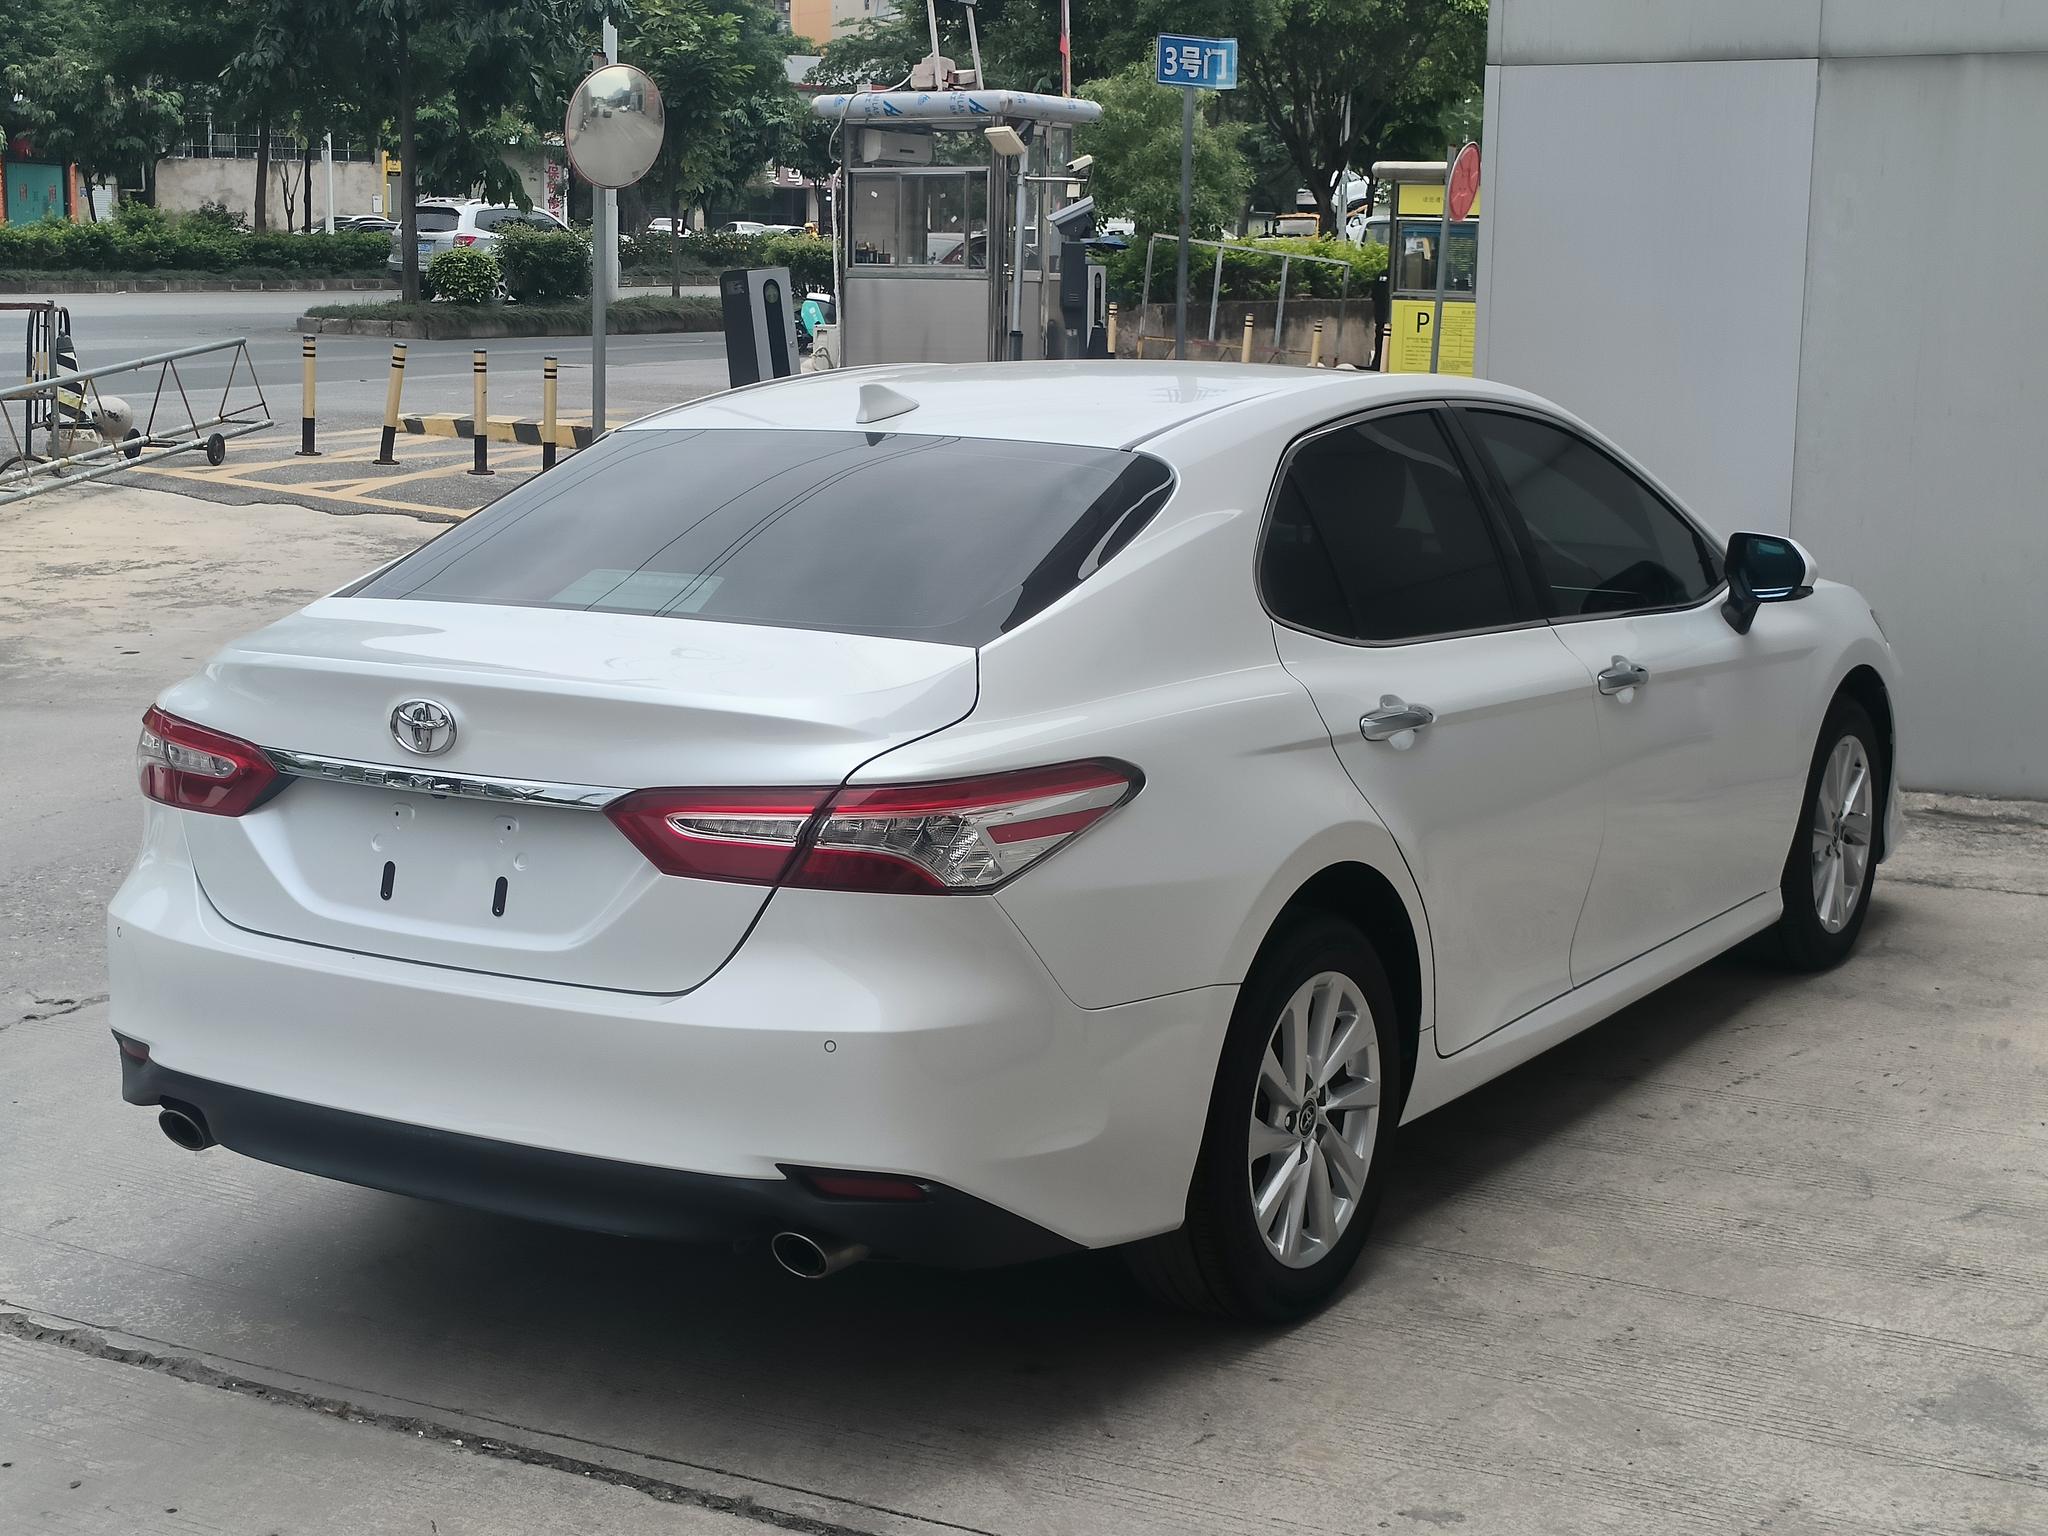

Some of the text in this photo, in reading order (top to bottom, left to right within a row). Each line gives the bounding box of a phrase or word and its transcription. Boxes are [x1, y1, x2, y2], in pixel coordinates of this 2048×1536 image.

[1164, 46, 1227, 80] 3号门
[1417, 311, 1430, 333] P
[321, 763, 545, 800] CAMRY
